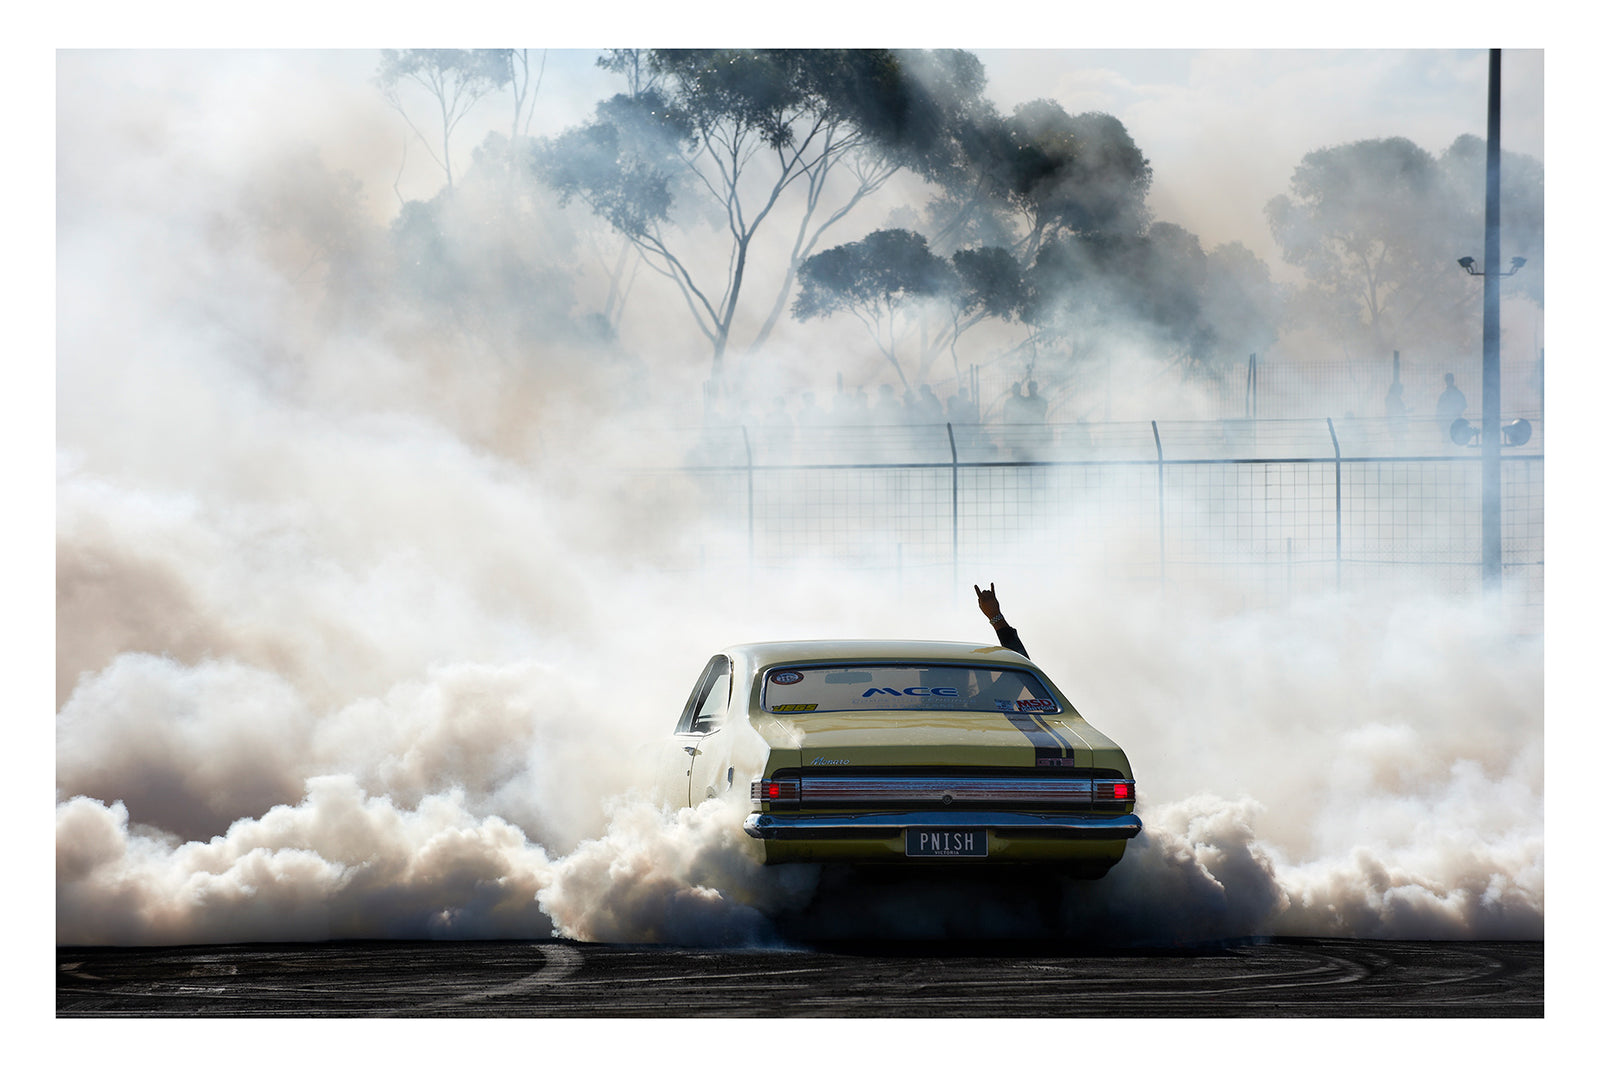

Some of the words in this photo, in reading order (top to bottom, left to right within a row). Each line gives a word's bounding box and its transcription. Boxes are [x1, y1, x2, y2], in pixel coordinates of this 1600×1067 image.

[862, 687, 958, 697] MCE
[1017, 699, 1052, 707] MSD
[920, 833, 973, 850] PNISH
